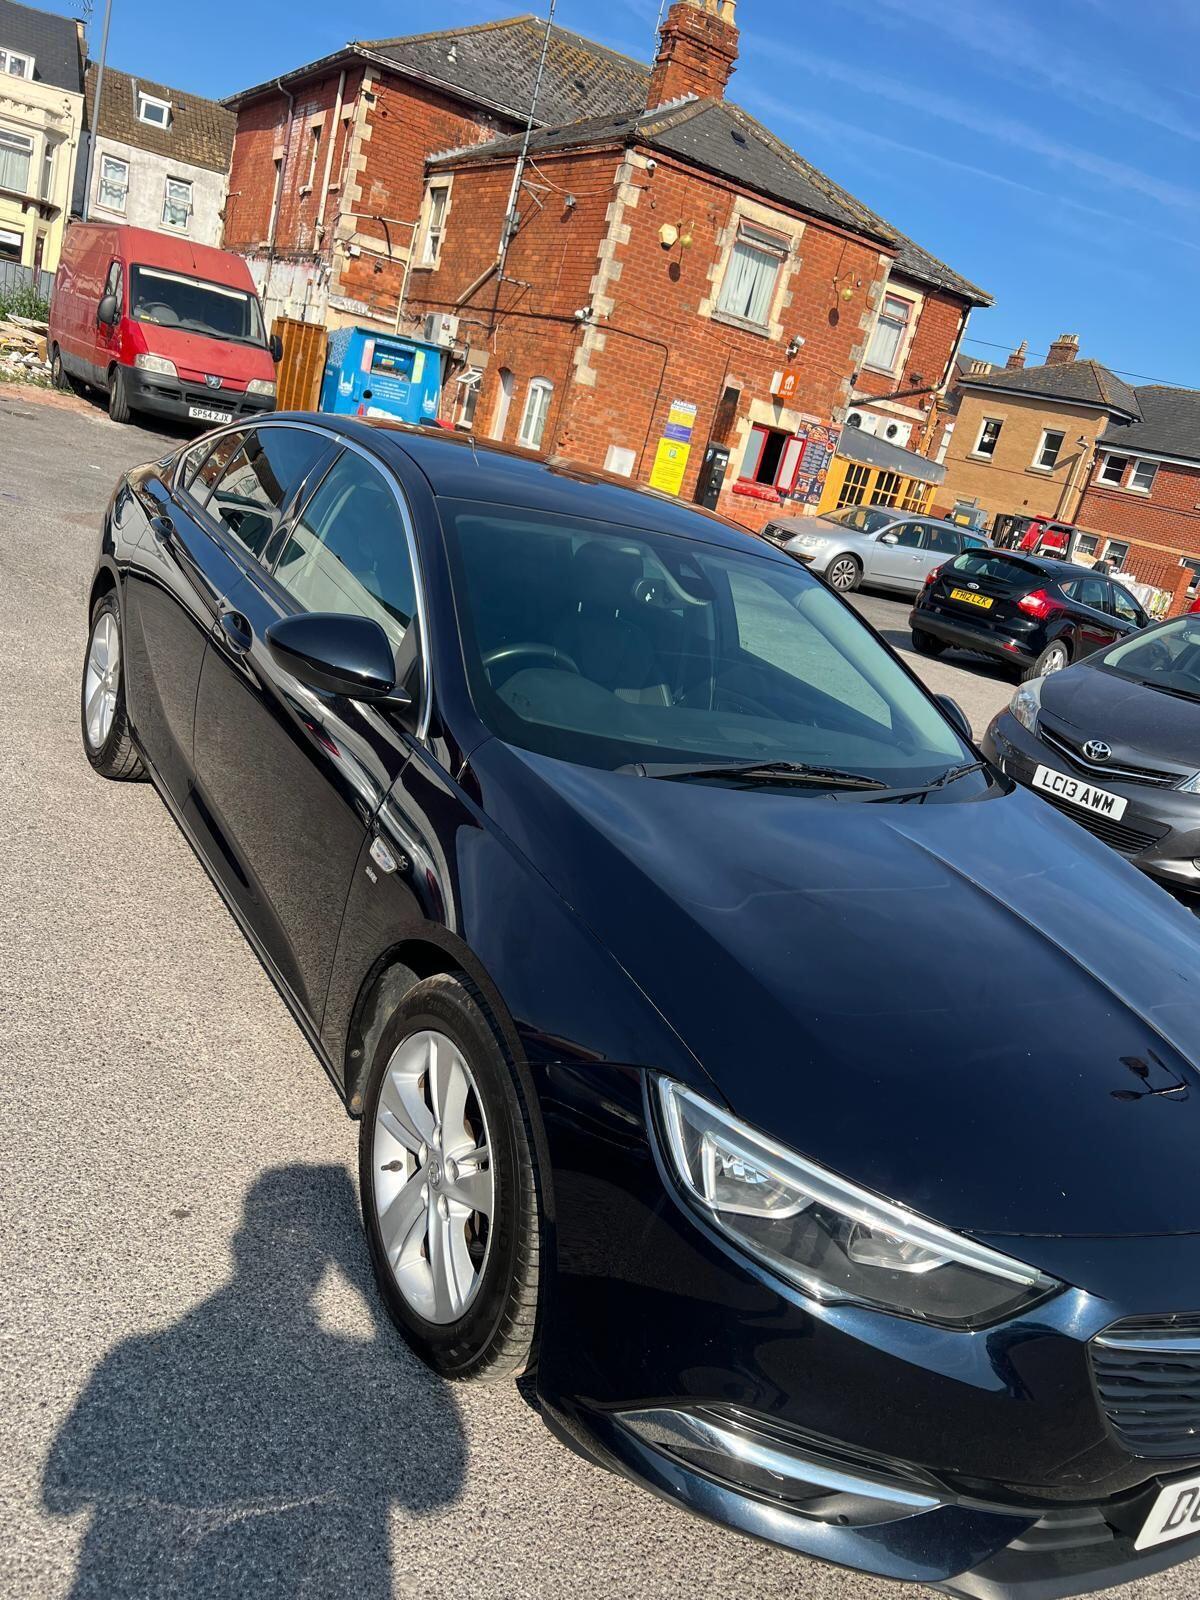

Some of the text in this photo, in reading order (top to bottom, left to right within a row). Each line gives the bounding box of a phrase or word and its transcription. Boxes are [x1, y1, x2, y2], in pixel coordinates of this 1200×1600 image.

[192, 408, 229, 422] SP54 ZJX
[955, 590, 970, 601] FH12
[971, 595, 989, 606] LZK
[1042, 771, 1115, 813] LC13 AWM
